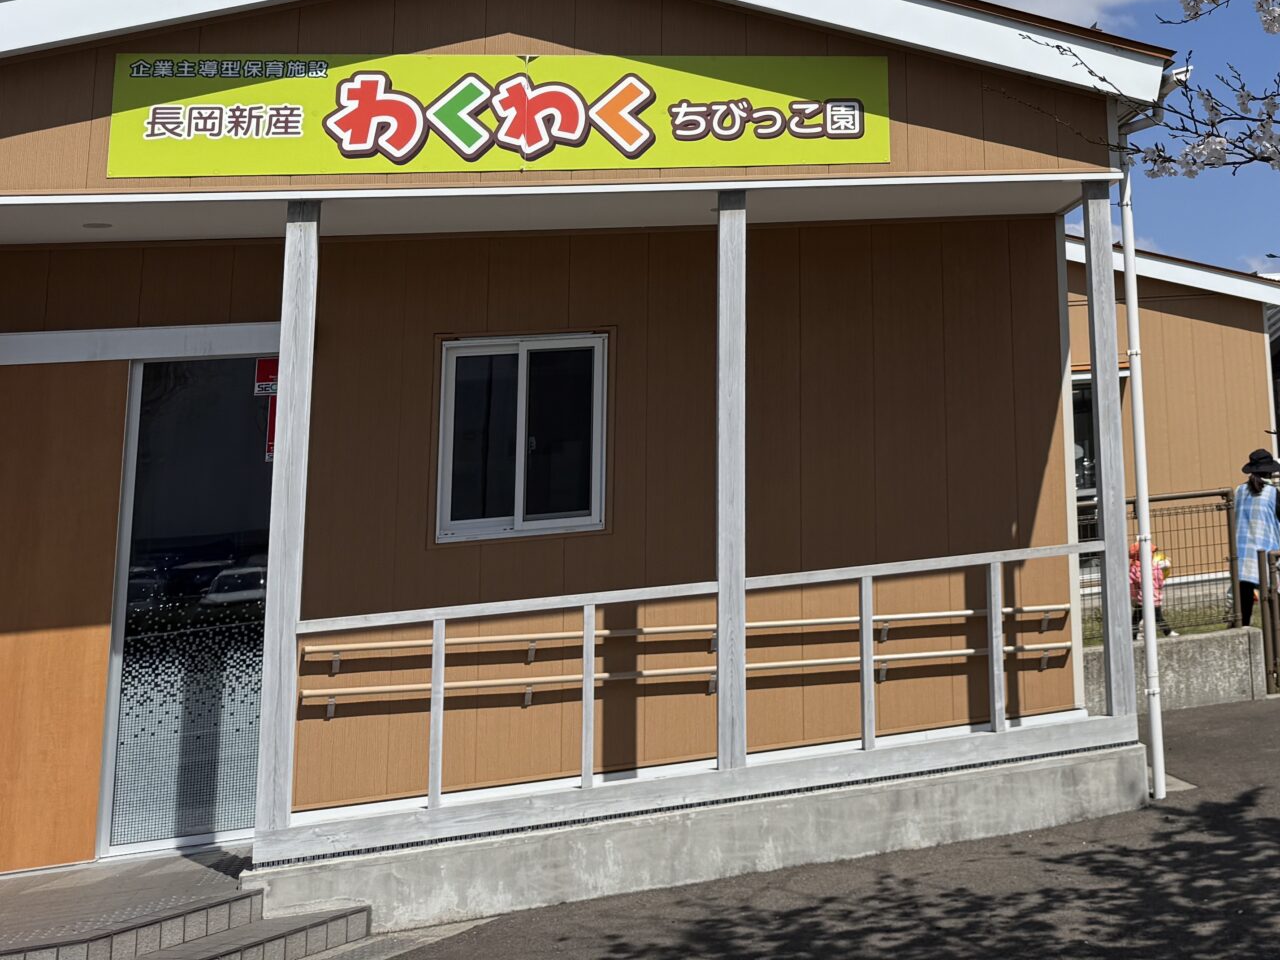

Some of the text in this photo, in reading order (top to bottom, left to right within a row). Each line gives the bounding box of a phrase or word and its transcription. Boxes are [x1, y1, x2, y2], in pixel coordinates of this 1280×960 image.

[130, 59, 328, 78] 企業主導型保育施設
[144, 71, 864, 165] 長岡新産 わくわく ちびっこ園
